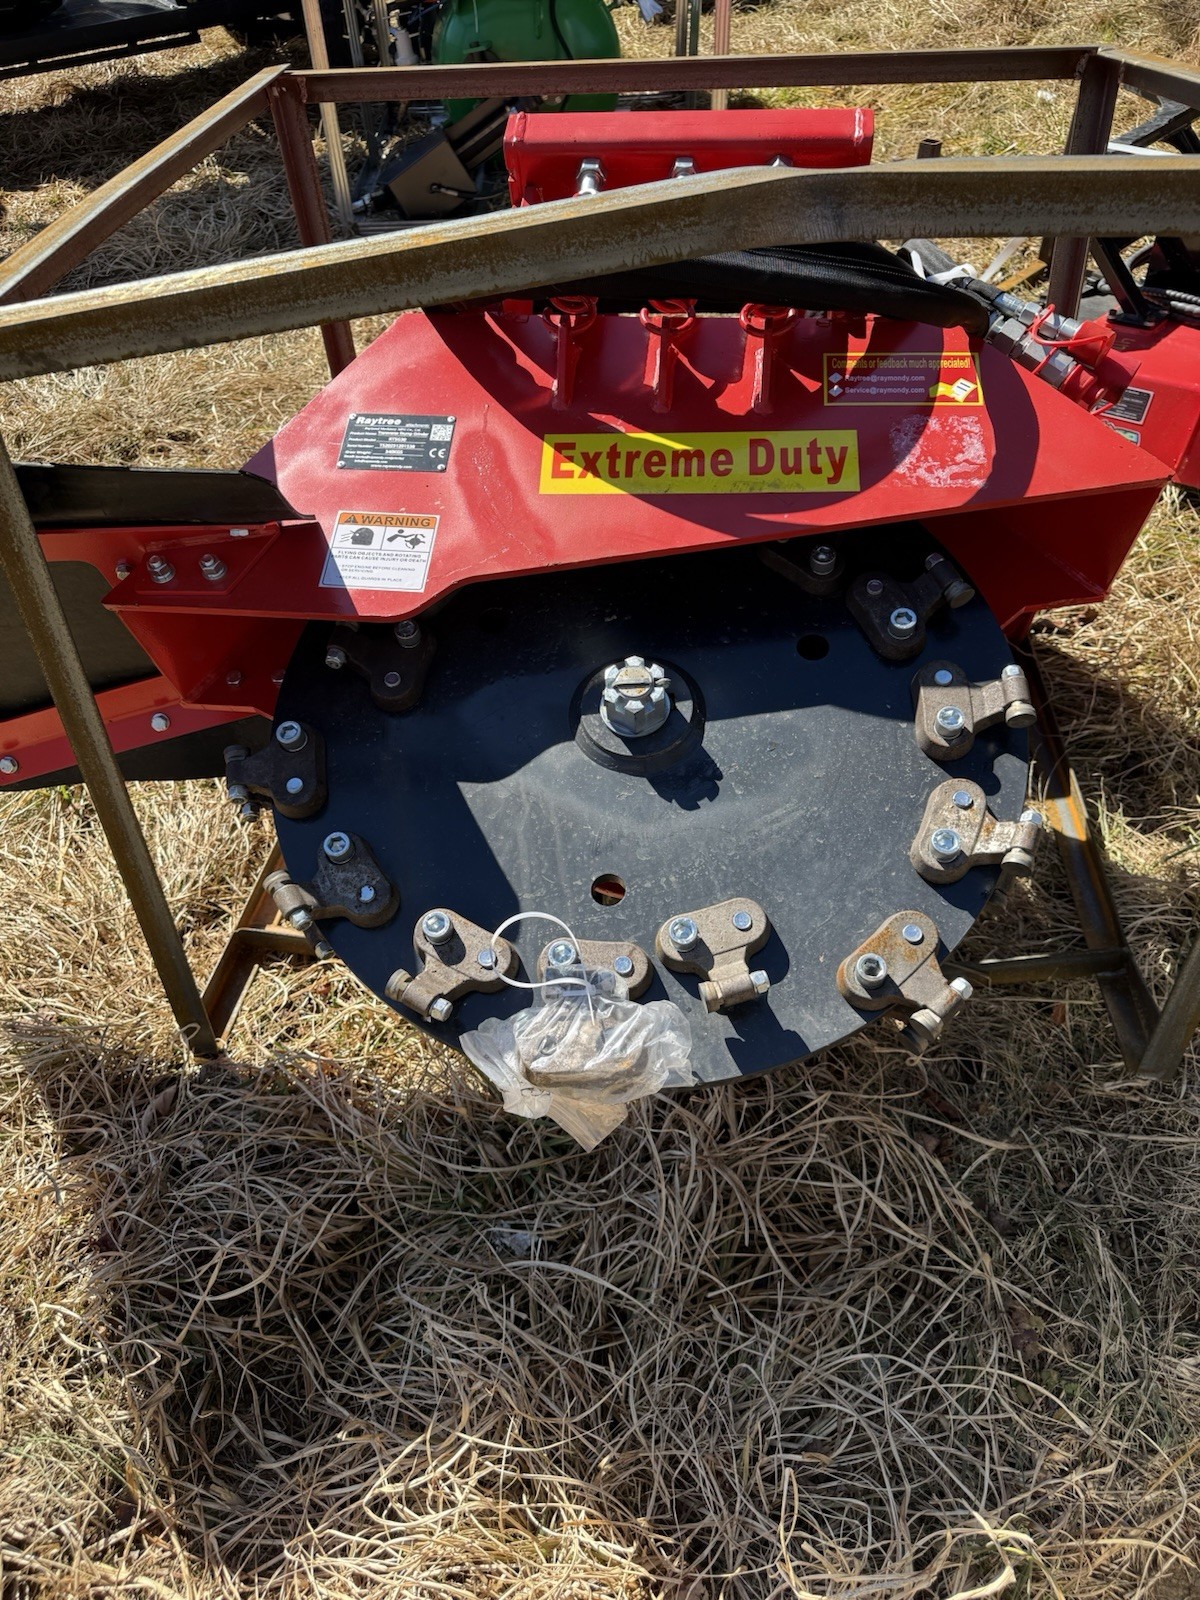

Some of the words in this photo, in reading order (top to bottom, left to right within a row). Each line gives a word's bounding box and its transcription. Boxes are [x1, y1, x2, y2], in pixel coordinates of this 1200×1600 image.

[831, 357, 867, 369] Comments
[868, 360, 876, 369] or
[877, 357, 908, 369] feedback
[909, 357, 927, 369] much
[928, 357, 971, 371] appreciated!
[845, 374, 926, 383] Raytree@raymondy.com
[845, 386, 926, 395] Service@raymondy.com
[356, 416, 403, 426] Raytree
[550, 441, 735, 480] Extreme
[748, 437, 849, 485] Duty
[361, 515, 431, 527] WARNING
